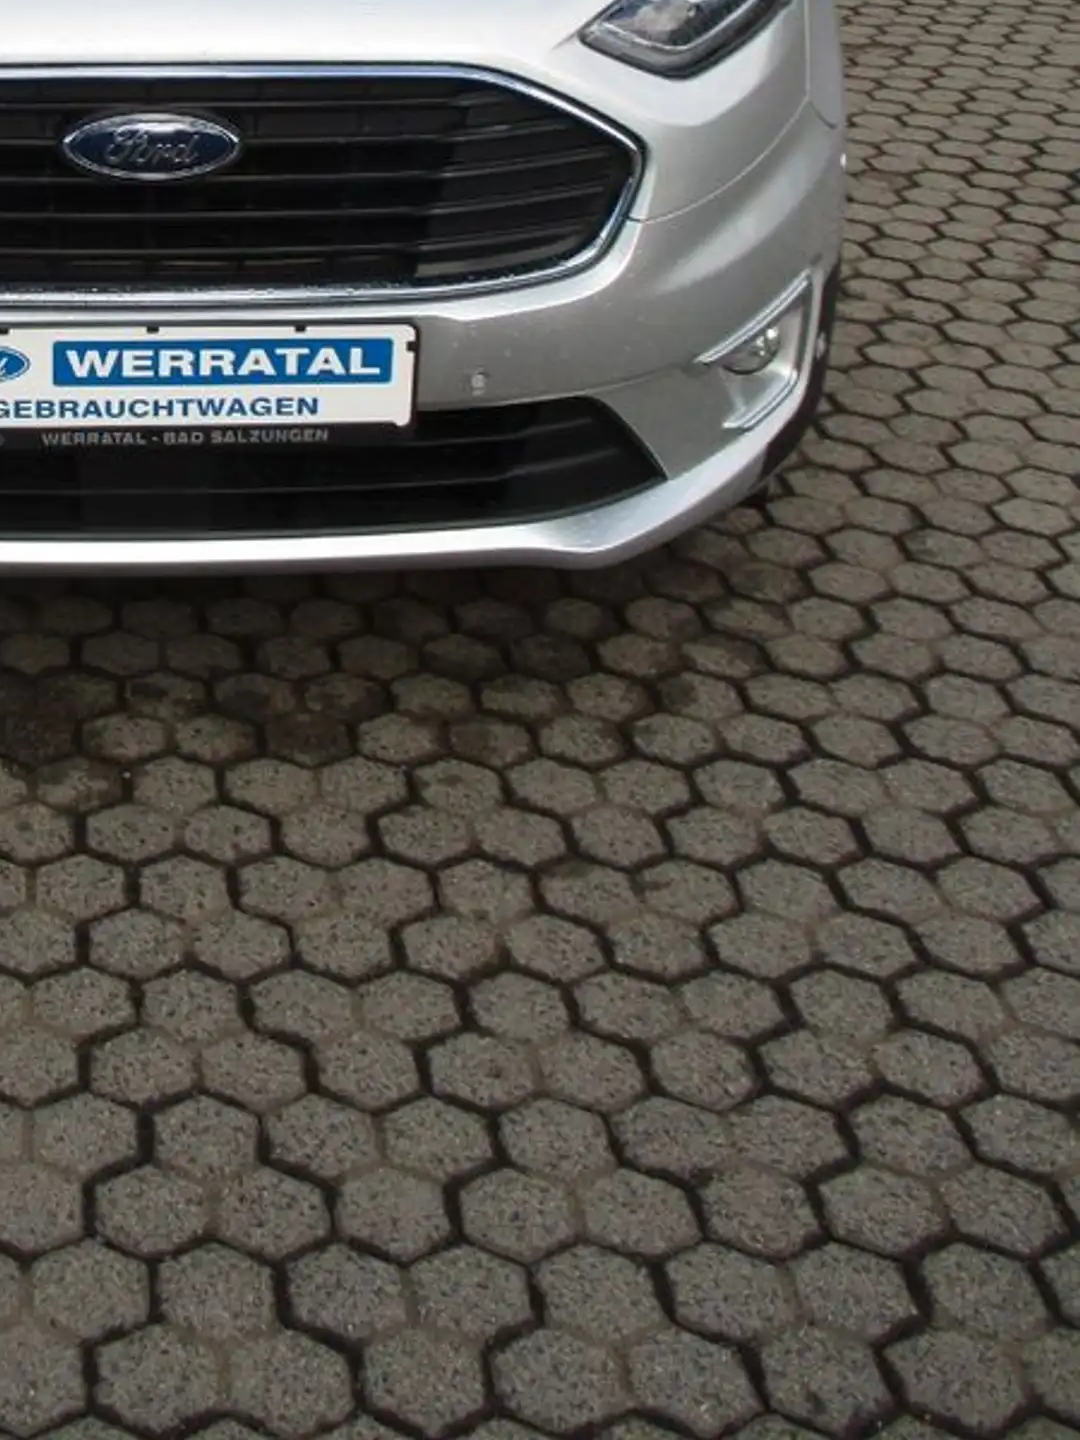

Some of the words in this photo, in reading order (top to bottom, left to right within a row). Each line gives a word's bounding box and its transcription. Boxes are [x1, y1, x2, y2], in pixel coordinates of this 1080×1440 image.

[65, 345, 382, 379] WERRATAL
[41, 431, 147, 446] WERRATAL
[163, 430, 205, 445] BAD
[211, 427, 330, 444] SALZUNGEN
